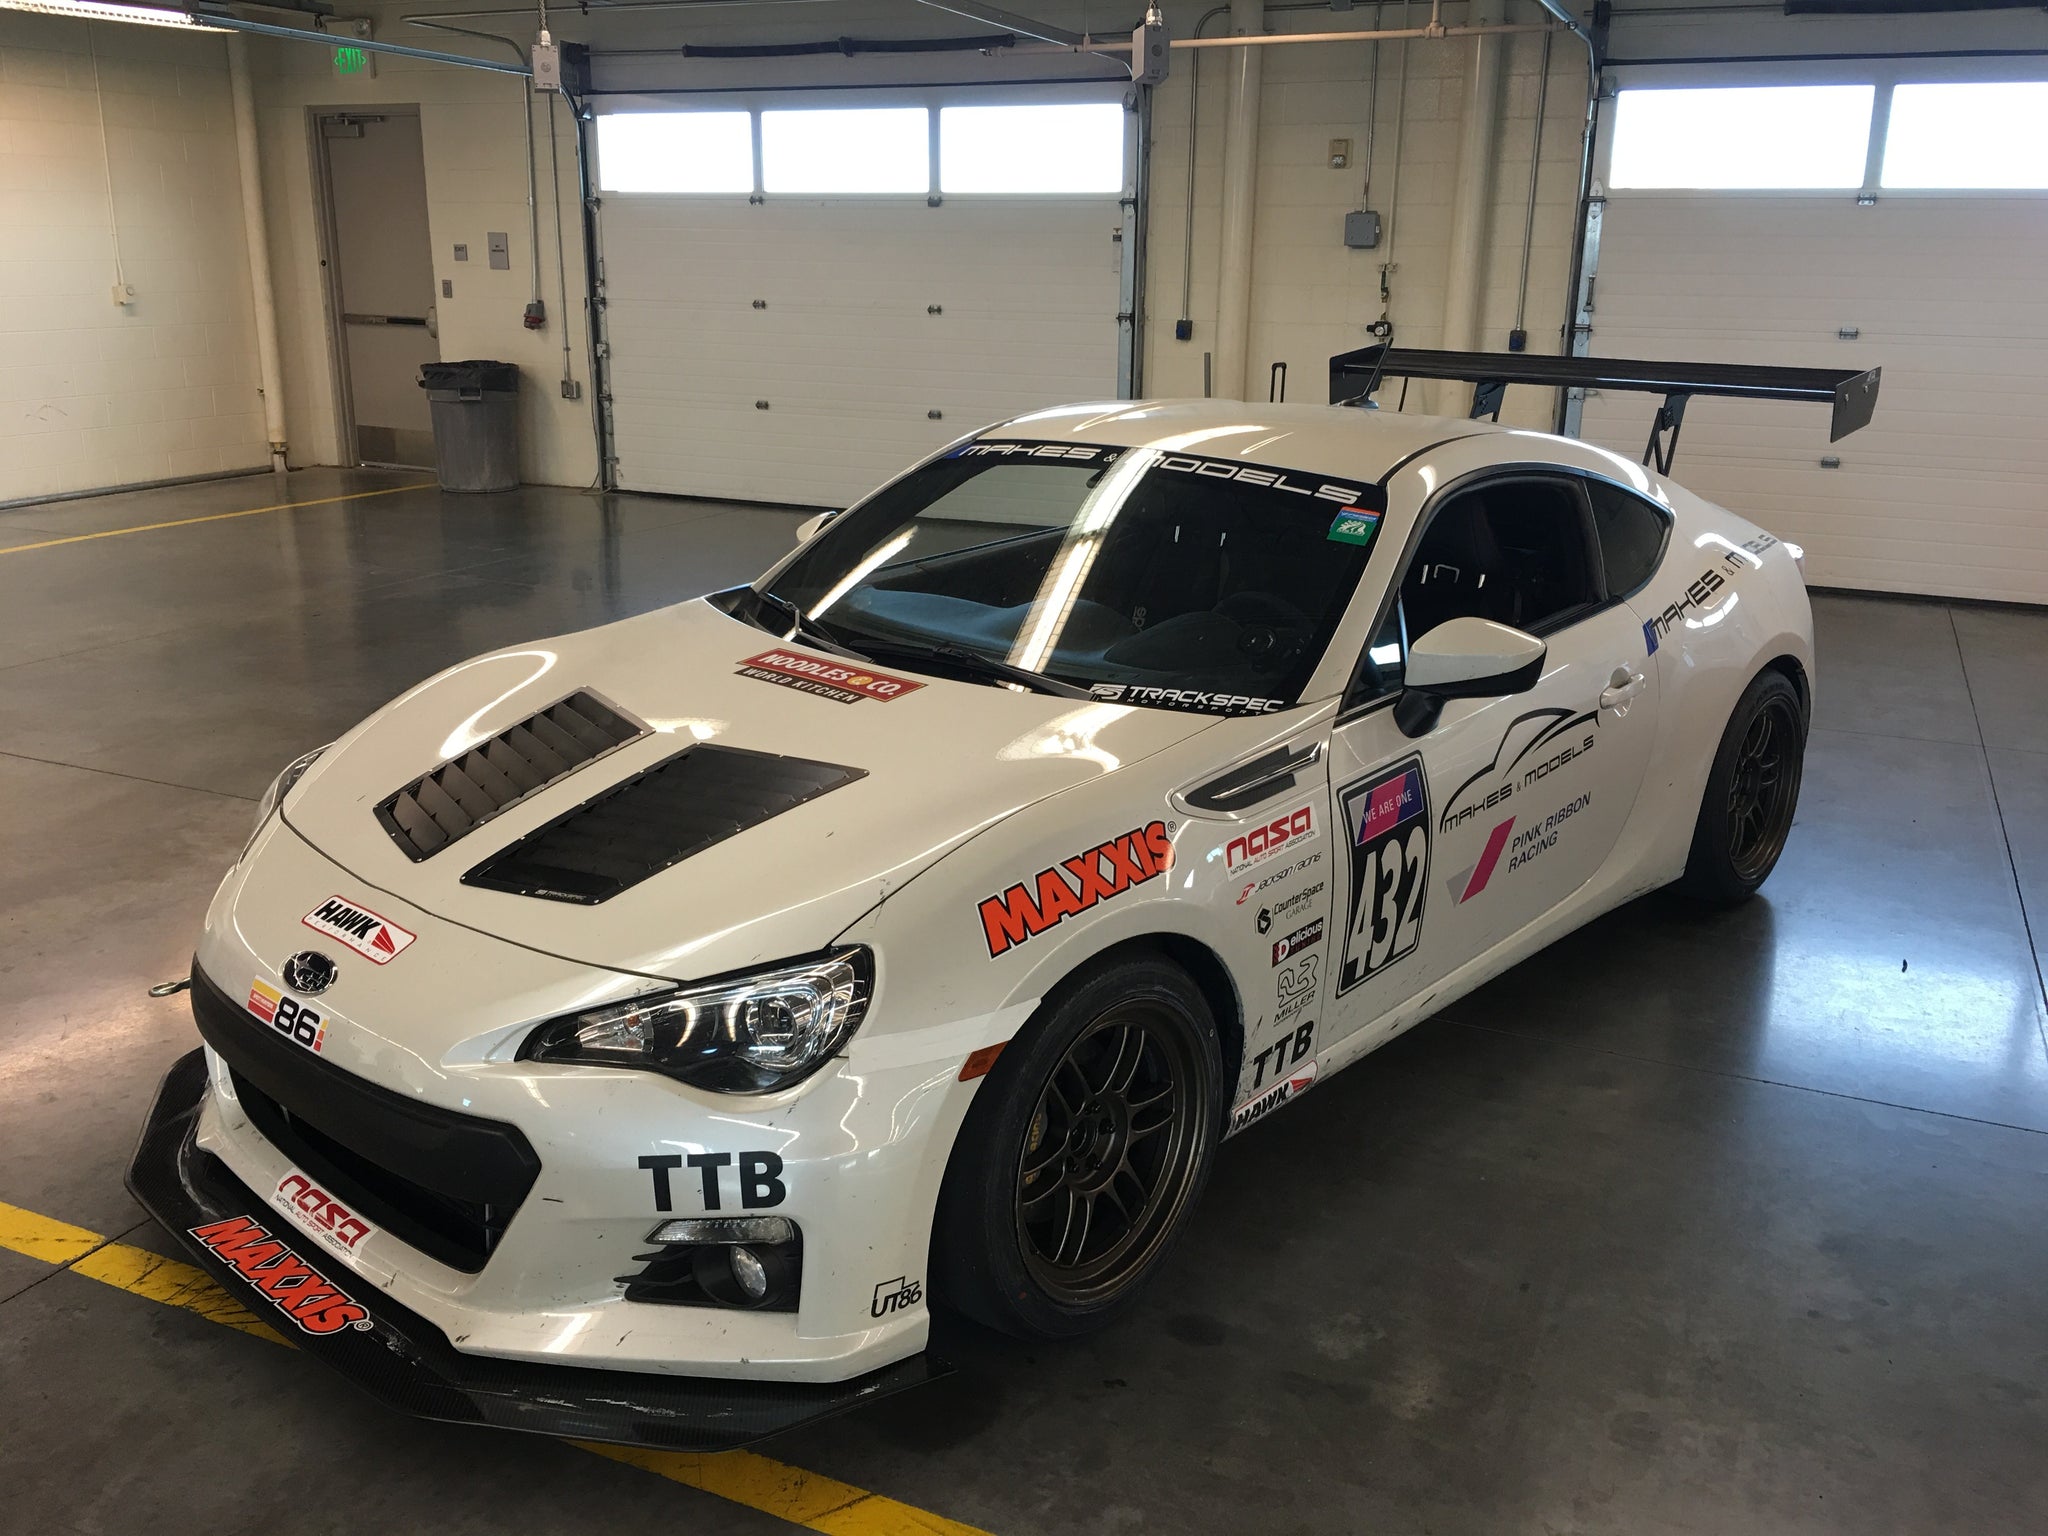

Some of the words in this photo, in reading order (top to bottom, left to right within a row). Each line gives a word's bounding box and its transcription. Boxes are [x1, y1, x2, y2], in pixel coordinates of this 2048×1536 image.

[338, 47, 363, 74] EXIT
[959, 444, 1102, 460] MAKES
[1103, 453, 1118, 463] &
[1650, 569, 1725, 640] MAKES
[744, 668, 791, 684] WORLD
[791, 681, 859, 702] KITCHEN
[758, 654, 855, 682] NOODLES
[1128, 686, 1285, 712] TRACKSPEC
[1444, 783, 1513, 834] MAKES
[1516, 781, 1522, 793] &
[1524, 734, 1594, 787] MODELS
[1363, 807, 1377, 824] WE
[1379, 799, 1395, 817] ARE
[1396, 790, 1412, 808] ONE
[1512, 822, 1542, 853] PINK
[1545, 791, 1591, 836] RIBBON
[1253, 853, 1267, 864] AUTO
[1267, 844, 1284, 858] SPORT
[1508, 831, 1558, 873] RACING
[313, 900, 382, 940] HAWK
[1285, 898, 1313, 920] GARAGE
[1346, 825, 1427, 980] 432
[1278, 921, 1323, 962] Delicious
[274, 996, 321, 1047] 86
[1274, 990, 1316, 1023] MILLER
[1253, 1020, 1315, 1091] TTB
[1234, 1080, 1291, 1131] HAWK
[638, 1151, 787, 1212] TTB
[295, 1211, 309, 1223] AUTO
[307, 1220, 325, 1235] SPORT
[871, 1283, 922, 1318] UT86
